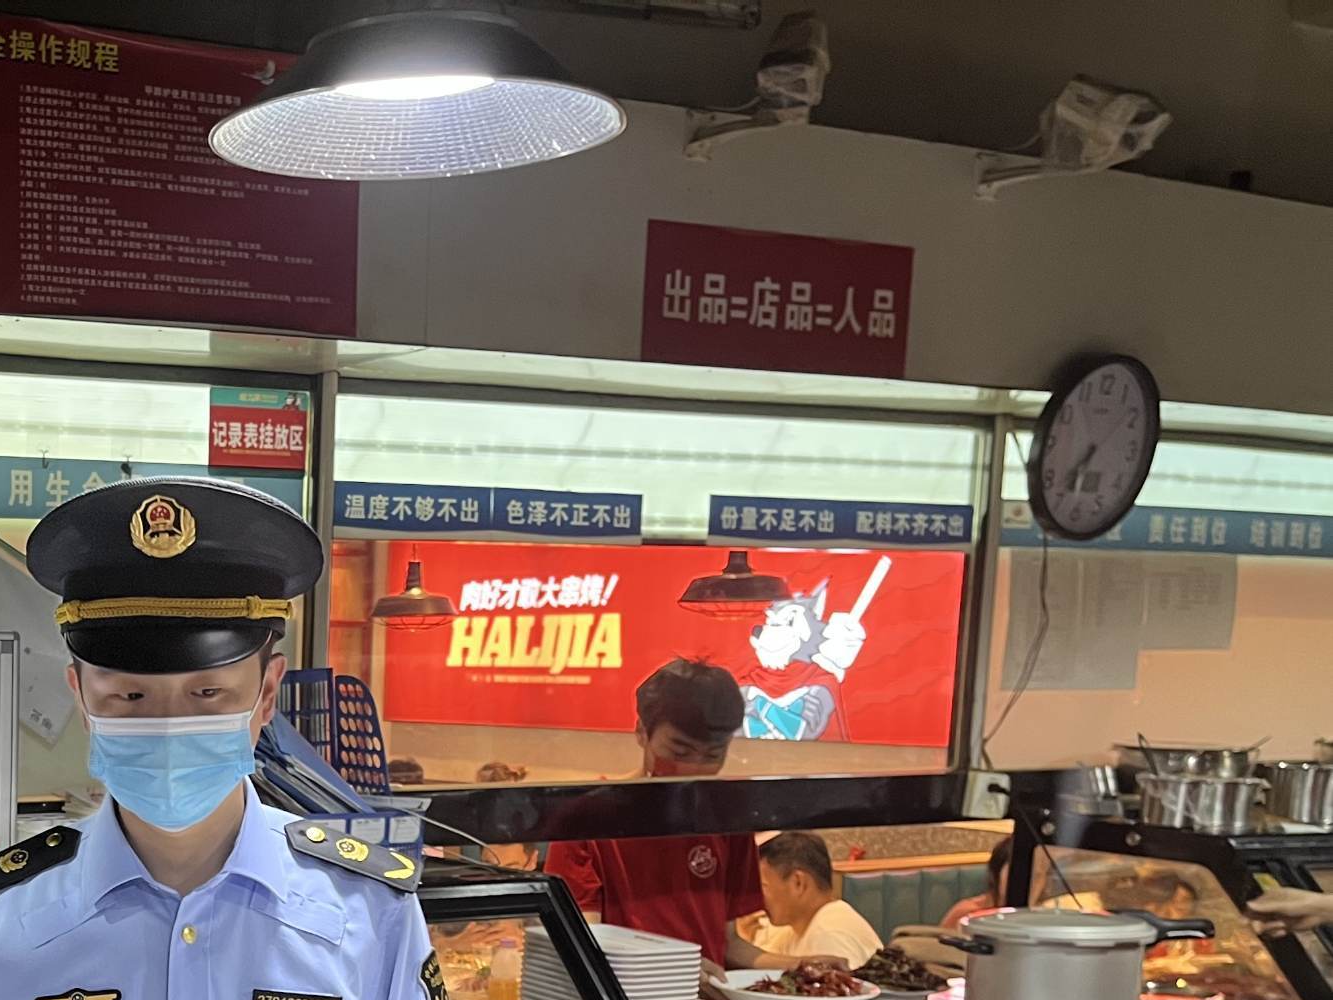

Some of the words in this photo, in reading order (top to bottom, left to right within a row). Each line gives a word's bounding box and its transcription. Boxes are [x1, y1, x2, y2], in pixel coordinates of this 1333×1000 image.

[662, 269, 896, 338] 出品=店品=人品
[211, 420, 304, 452] 记录表挂放区
[344, 493, 480, 524] 温度不够不出
[506, 499, 632, 529] 色泽不正不出
[720, 505, 836, 535] 份量不足不出
[856, 511, 965, 538] 配料不齐不出
[1148, 513, 1227, 546] 责任到位
[446, 613, 623, 676] HALIJIA
